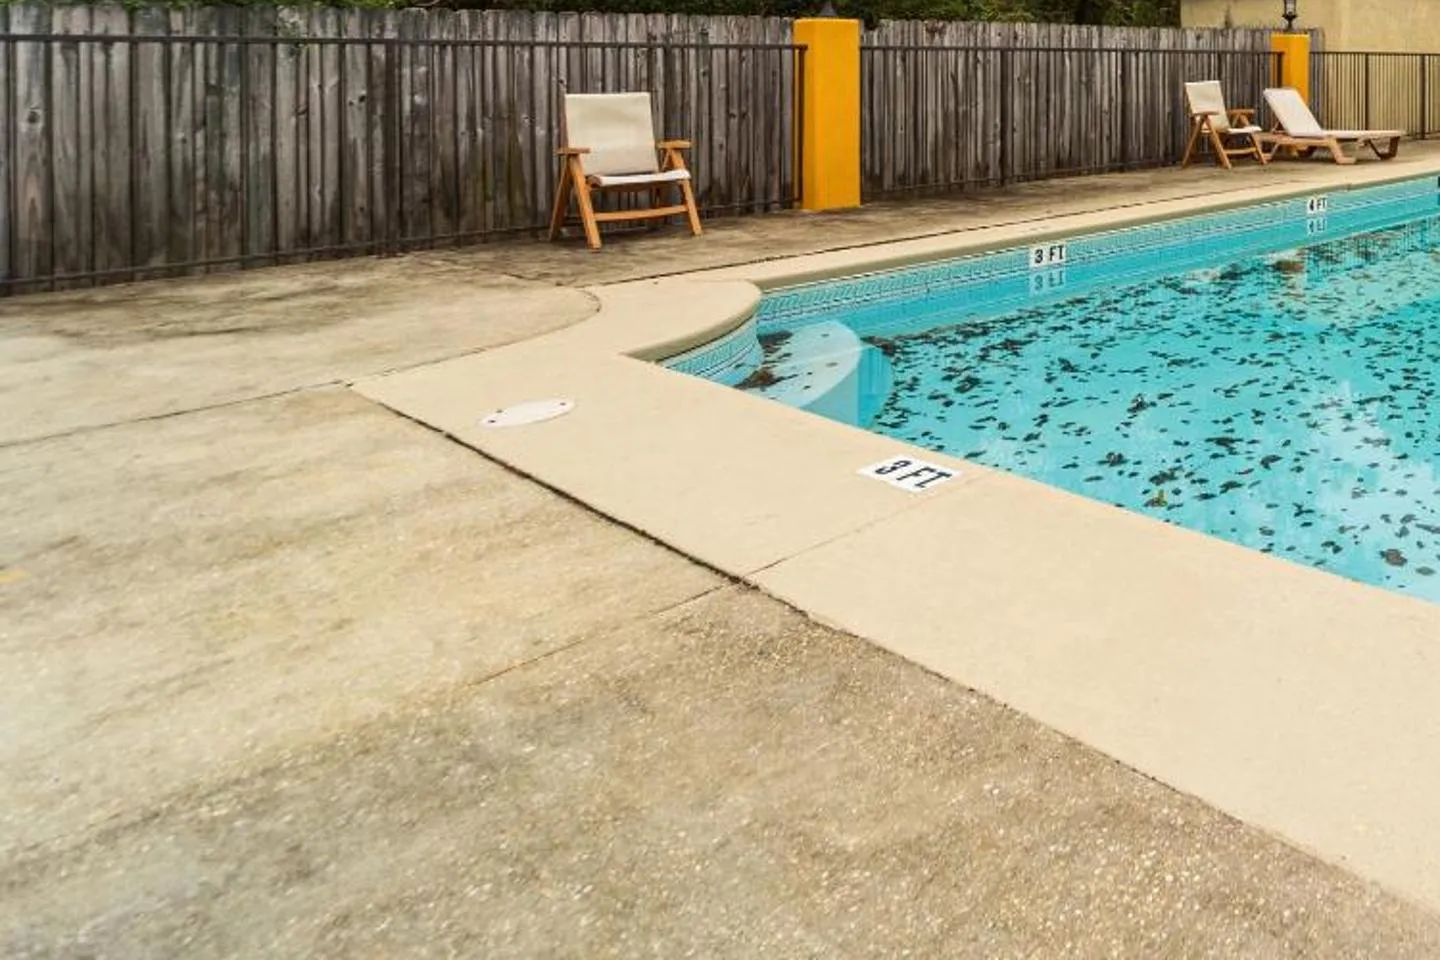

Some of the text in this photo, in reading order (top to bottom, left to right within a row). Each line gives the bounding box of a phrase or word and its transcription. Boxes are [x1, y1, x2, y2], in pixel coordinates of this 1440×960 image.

[1034, 244, 1064, 264] 3 FT
[896, 466, 952, 488] FT
